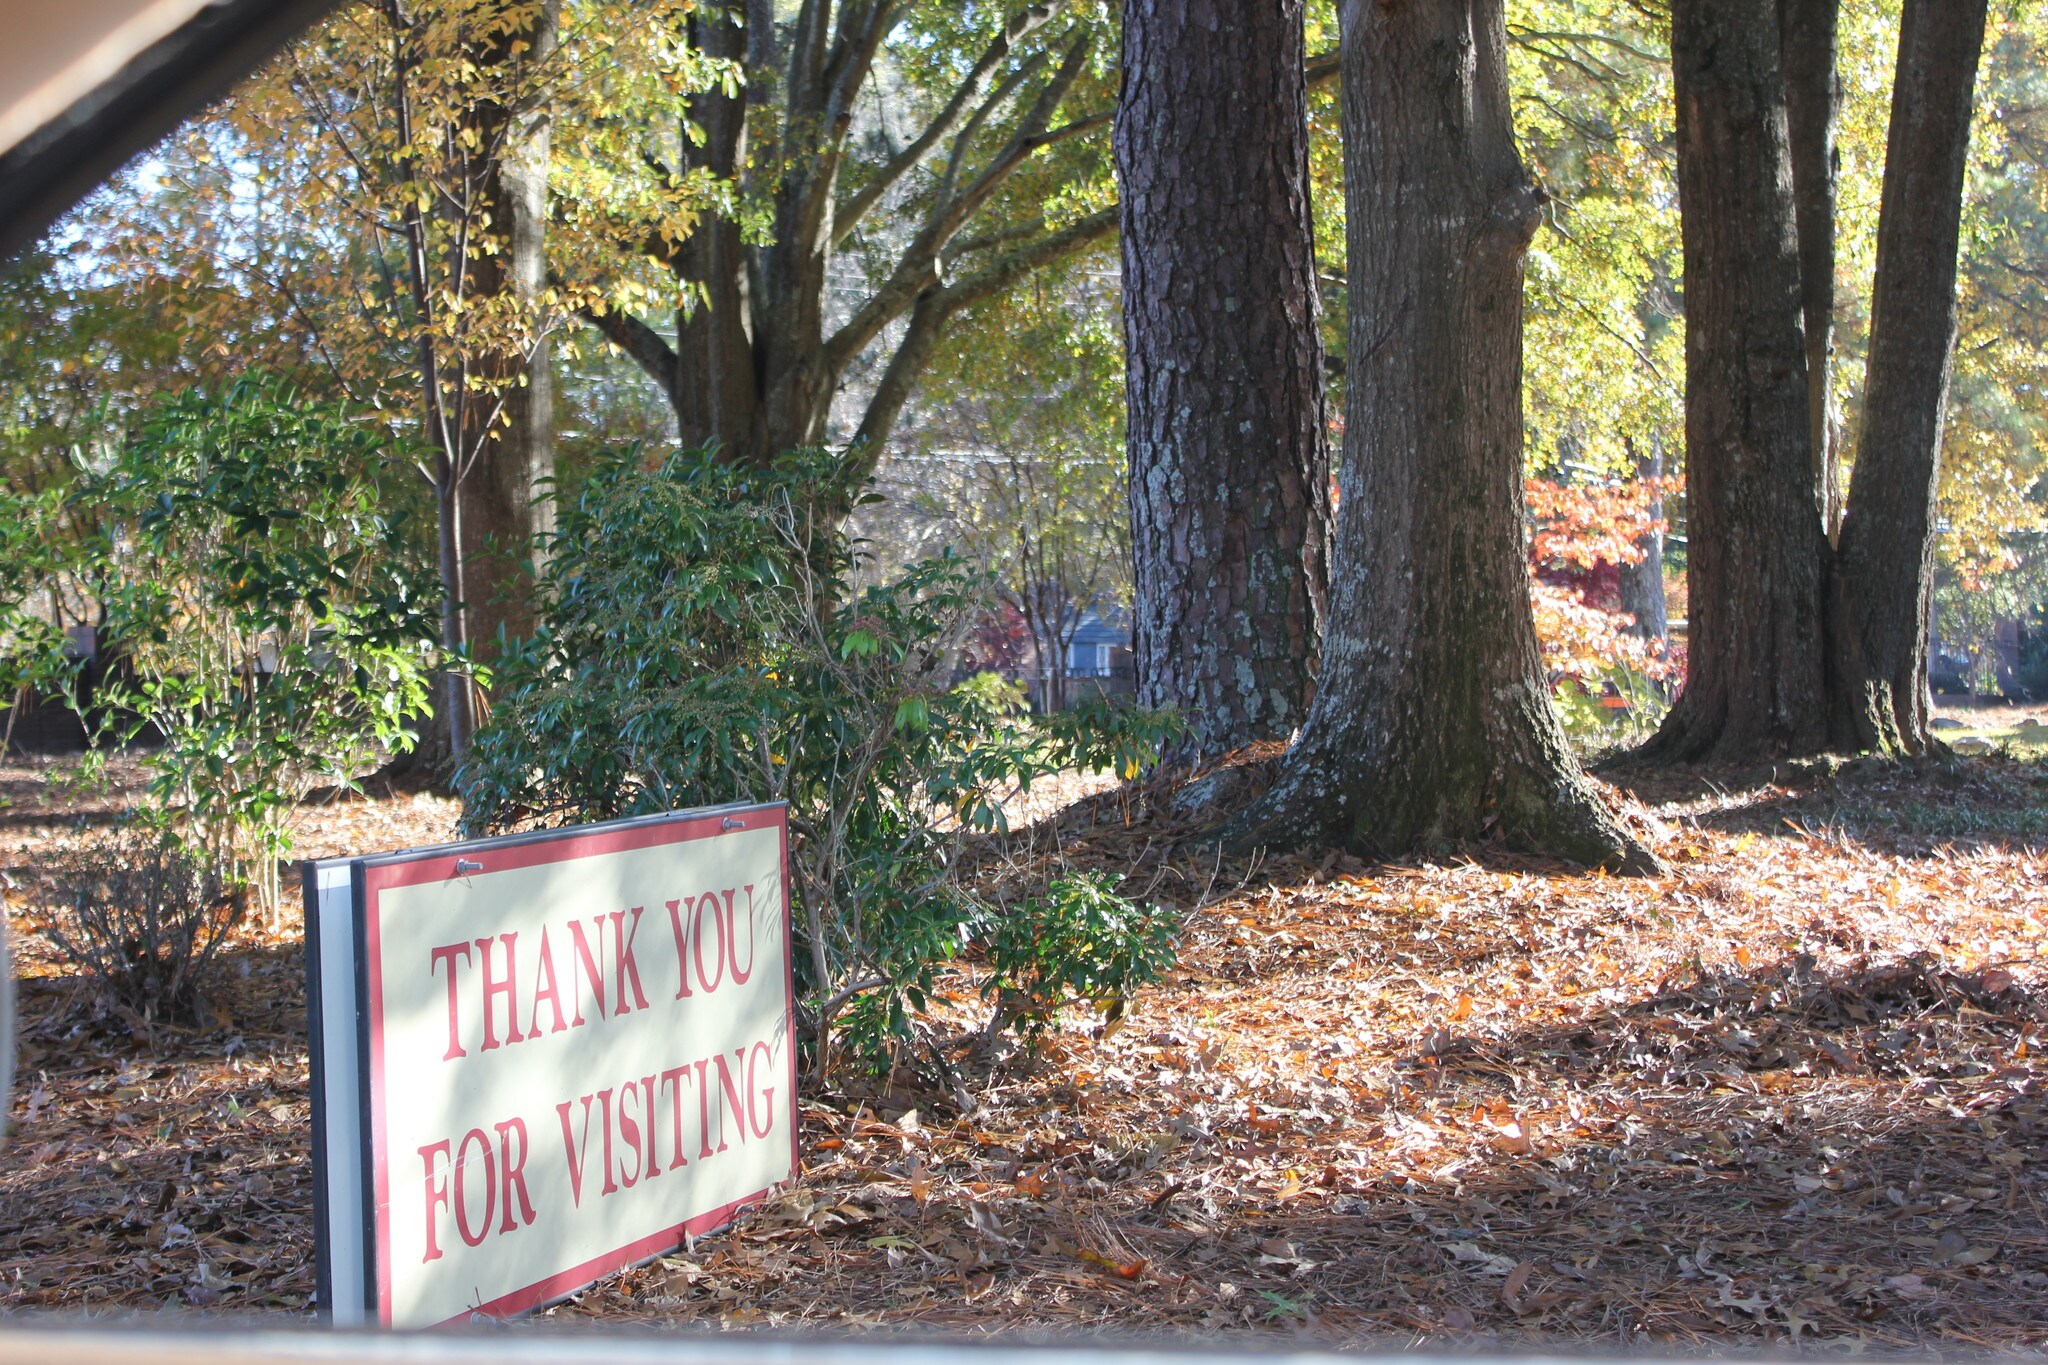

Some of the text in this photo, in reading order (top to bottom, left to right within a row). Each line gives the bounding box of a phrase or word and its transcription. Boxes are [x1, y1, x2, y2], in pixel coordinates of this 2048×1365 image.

[431, 884, 754, 1062] THANK YOU
[417, 1041, 774, 1264] FOR VISITING
